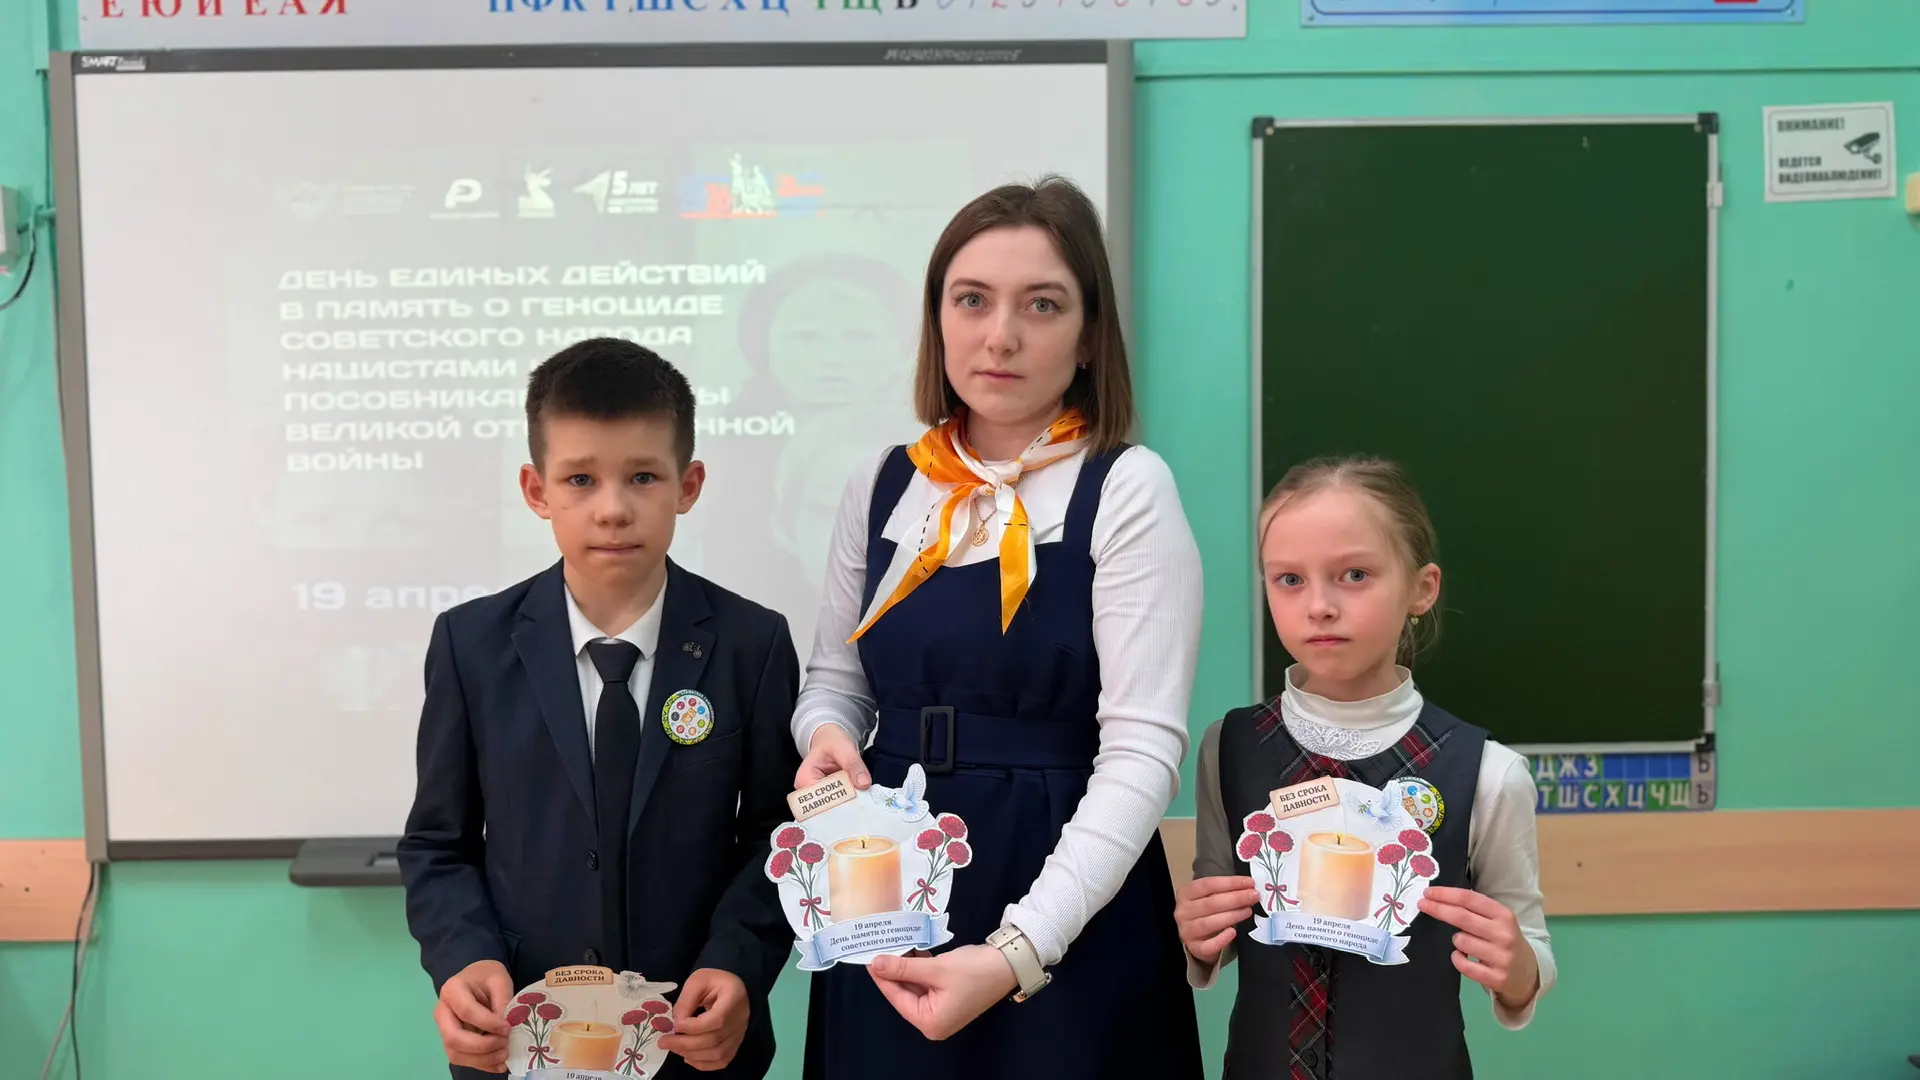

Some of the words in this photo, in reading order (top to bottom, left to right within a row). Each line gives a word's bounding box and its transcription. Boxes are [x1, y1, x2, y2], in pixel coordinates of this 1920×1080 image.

[278, 269, 379, 290] ДЕНЬ
[389, 266, 551, 288] ЕДИНЫХ
[560, 259, 767, 286] ДЕЙСТВИЙ
[280, 301, 304, 321] В
[316, 299, 473, 321] ПАМЯТЬ
[483, 297, 510, 318] О
[521, 294, 724, 317] ГЕНОЦИДЕ
[280, 327, 525, 351] СОВЕТСКОГО
[282, 358, 518, 382] НАЦИСТАМИ
[284, 388, 527, 411] ПОСОБНИКА
[285, 413, 462, 442] ВЕЛИКОЙ
[287, 447, 424, 472] ВОЙНЫ
[292, 581, 346, 611] 19
[365, 584, 509, 613] апре
[797, 792, 814, 804] БЕЗ
[814, 780, 844, 797] СРОКА
[801, 788, 848, 815] ДАВНОСТИ
[1279, 792, 1296, 803] БЕЗ
[1297, 784, 1328, 798] СРОКА
[1283, 793, 1331, 813] ДАВНОСТИ
[854, 922, 864, 931] 19
[864, 919, 893, 930] апреля
[1285, 921, 1305, 930] День
[1306, 925, 1336, 936] памяти
[1343, 931, 1379, 945] геноциде
[1312, 917, 1322, 925] 19
[1322, 919, 1351, 930] апреля
[829, 936, 850, 947] День
[850, 930, 880, 941] памяти
[886, 925, 922, 935] геноциде
[840, 937, 885, 952] советского
[885, 934, 914, 944] народа
[1293, 931, 1338, 944] советского
[1338, 938, 1368, 950] народа
[555, 975, 605, 983] ДАВНОСТИ
